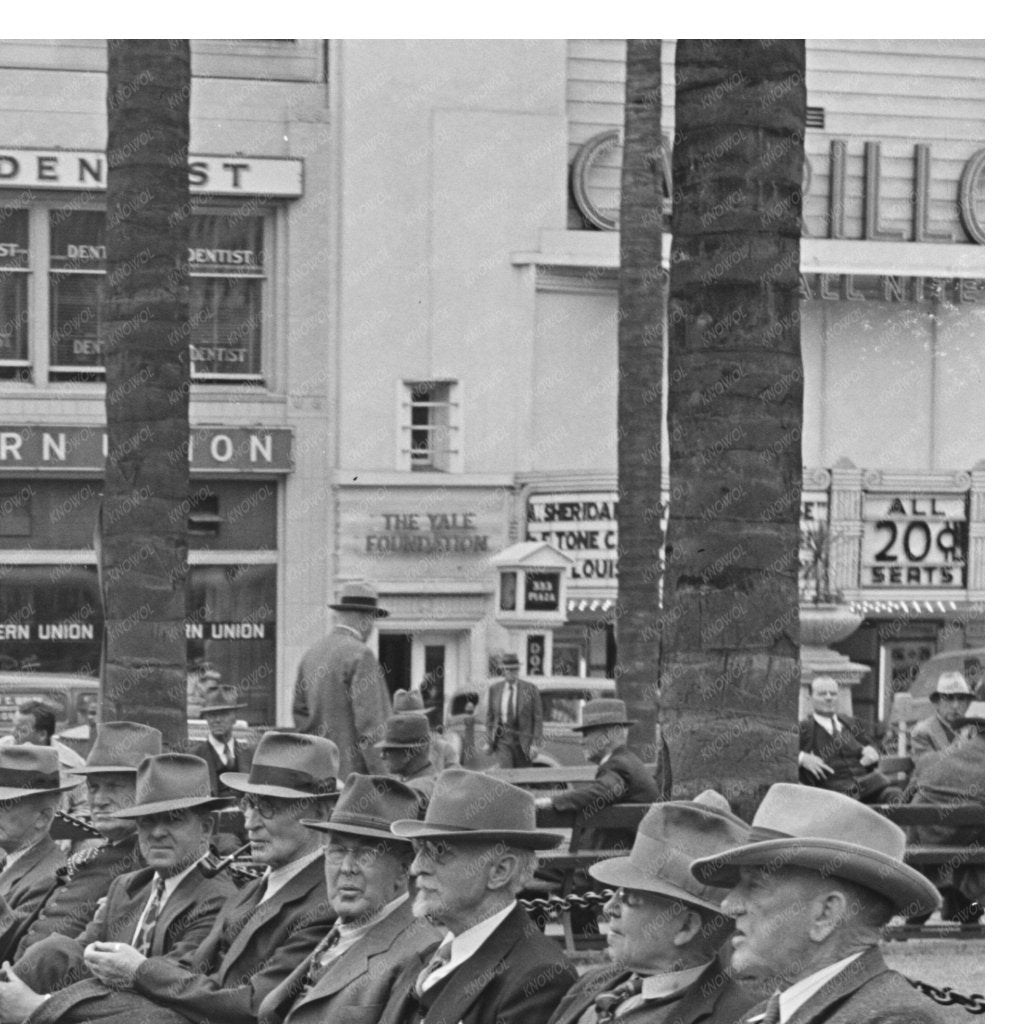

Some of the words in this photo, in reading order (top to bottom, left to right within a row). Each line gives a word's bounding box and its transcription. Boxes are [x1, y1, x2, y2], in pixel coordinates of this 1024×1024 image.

[102, 433, 273, 463] ION
[545, 501, 619, 521] SHERIDA
[887, 498, 947, 517] ALL
[381, 513, 420, 530] THE
[428, 512, 477, 530] YALE
[365, 534, 489, 553] FOUNDATION
[555, 531, 599, 550] TONE
[872, 566, 953, 584] SEATS
[38, 624, 94, 640] UNION
[211, 623, 265, 640] UNION
